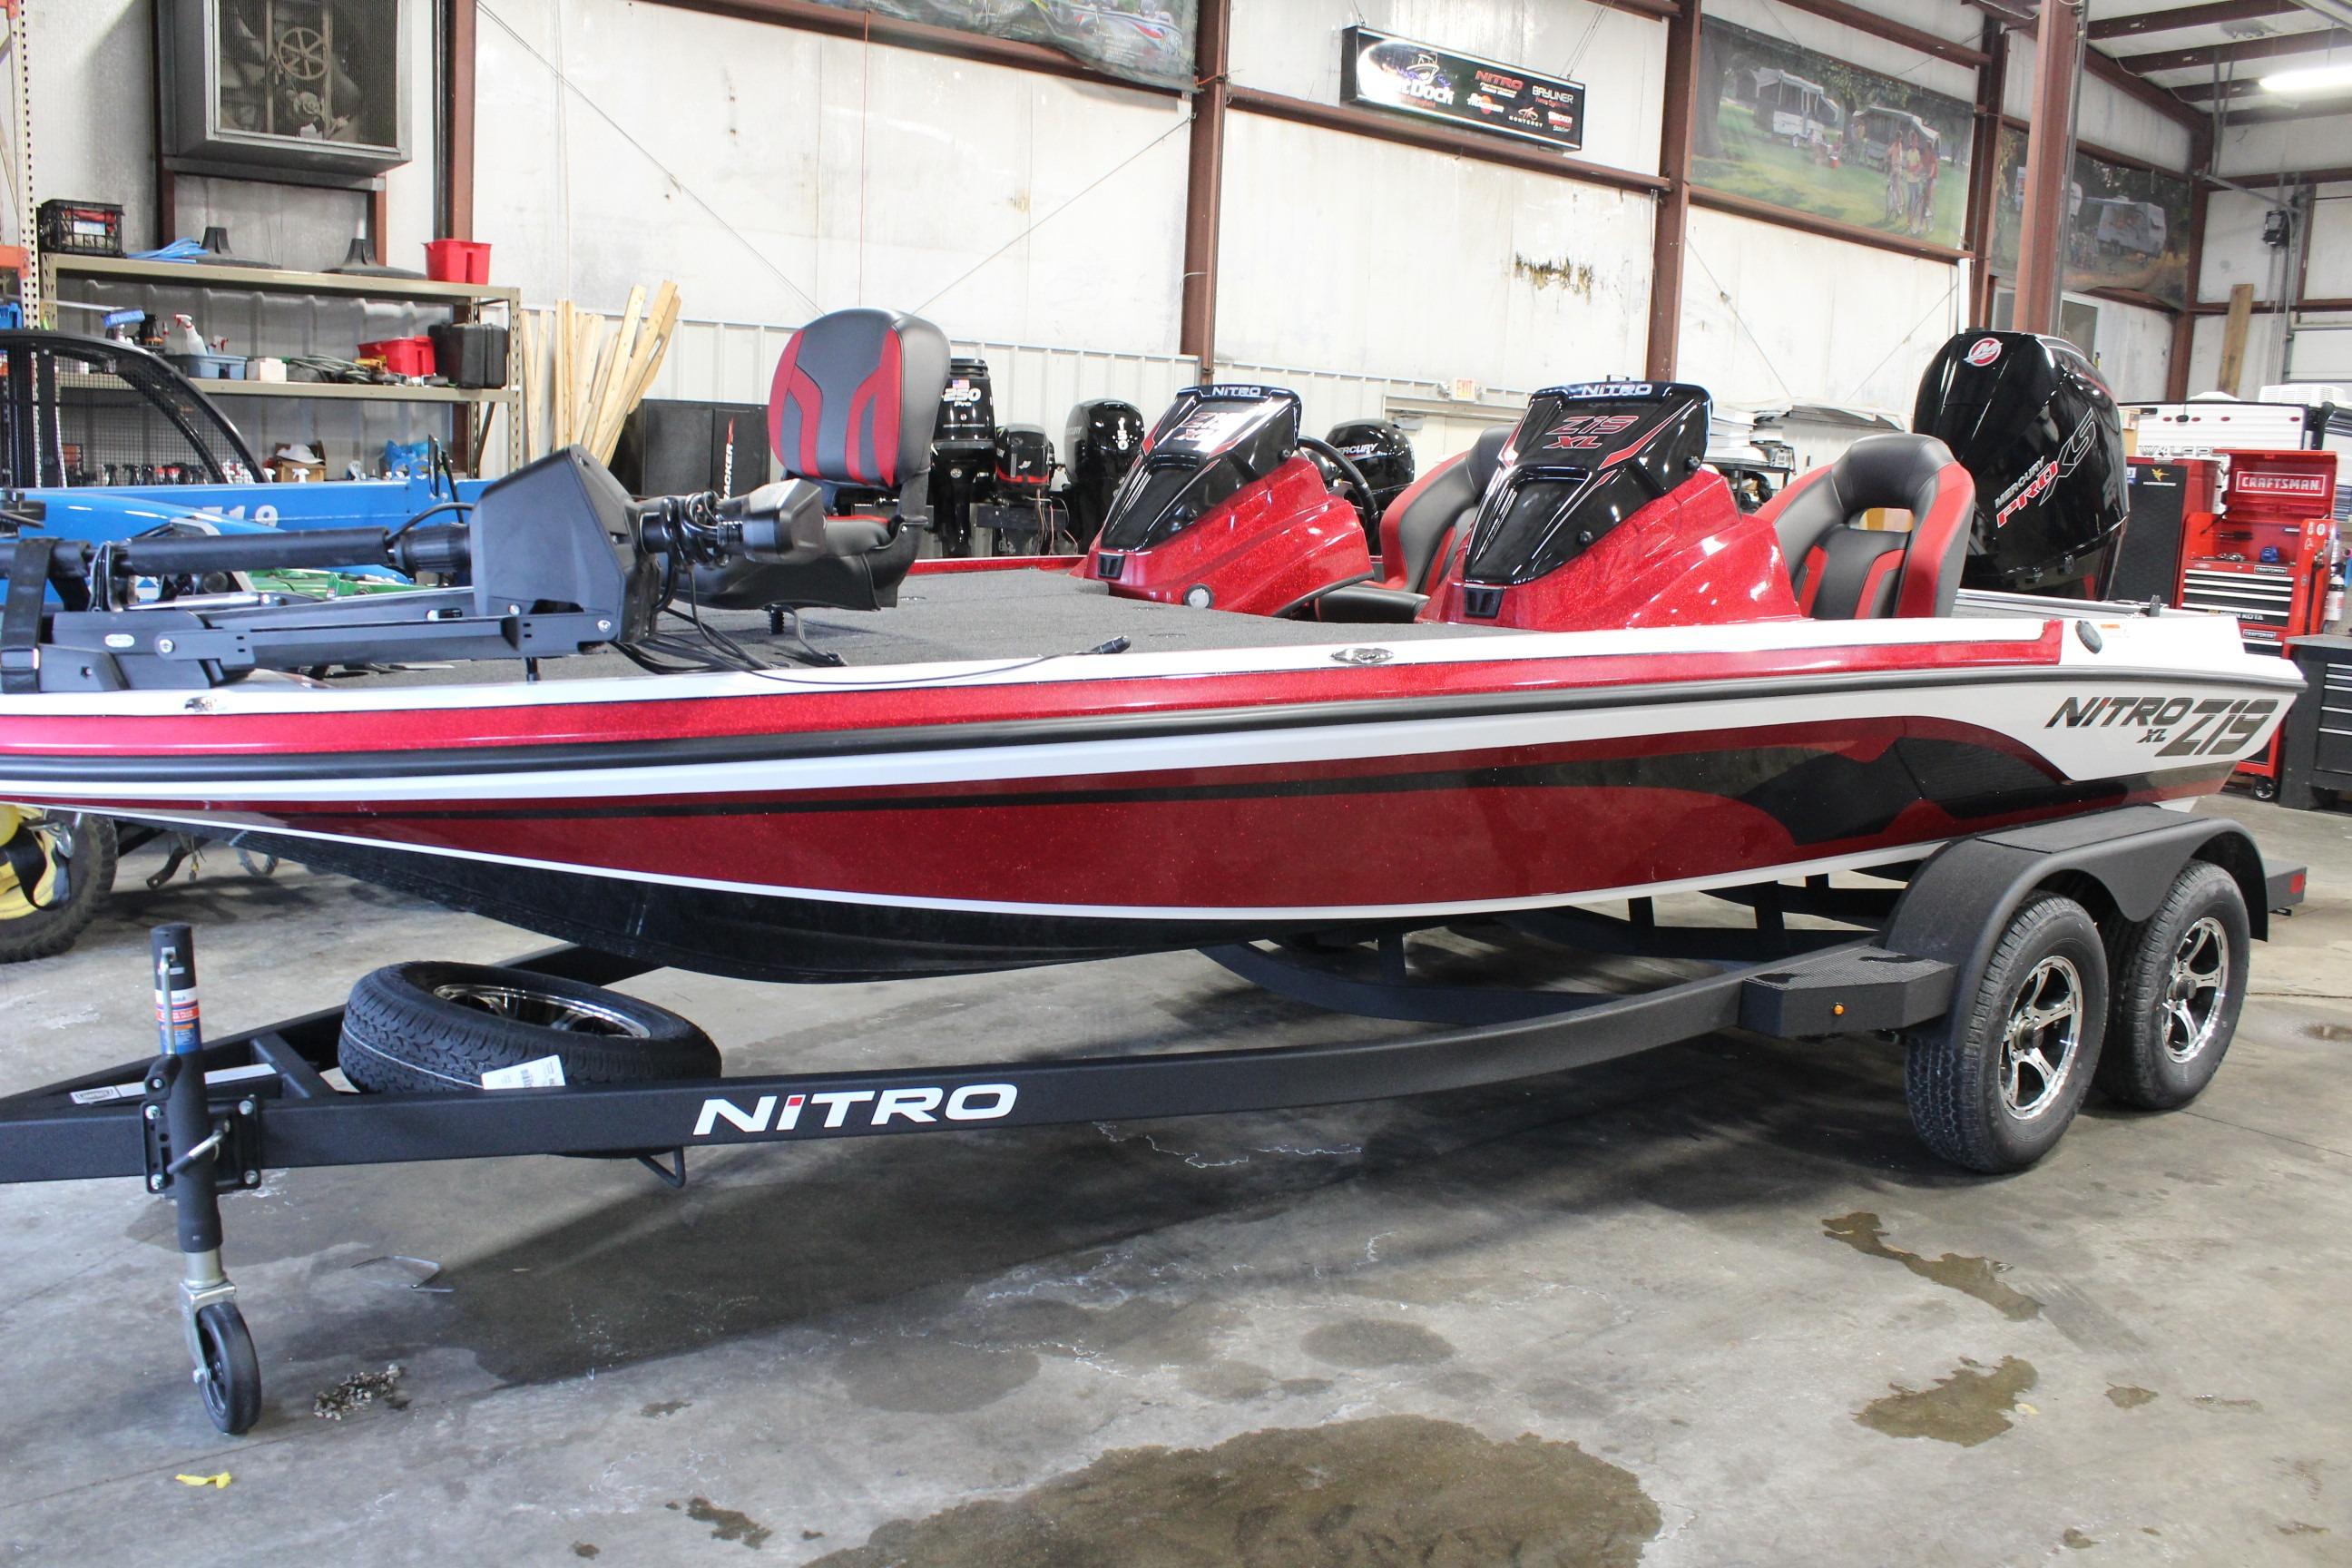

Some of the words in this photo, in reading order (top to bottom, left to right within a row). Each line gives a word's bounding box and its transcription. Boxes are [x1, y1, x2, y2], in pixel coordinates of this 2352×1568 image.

[1475, 70, 1524, 91] NITRO
[1532, 85, 1578, 104] BAYLINER
[1212, 387, 1261, 397] NITRO
[1456, 379, 1472, 392] EXIT
[1582, 384, 1653, 397] NITRO
[943, 387, 982, 402] 250
[1117, 416, 1130, 451] 150
[1545, 416, 1640, 436] Z19
[1337, 443, 1378, 455] ERCURY
[1543, 436, 1603, 449] XL
[1994, 455, 2045, 508] MERCURY
[2241, 476, 2321, 491] CRAFTSMAN
[1996, 460, 2059, 528] PRO
[2241, 612, 2264, 621] KOTA
[2043, 697, 2194, 730] NITRO
[2154, 699, 2279, 758] Z19
[2137, 729, 2168, 743] XL
[692, 1083, 1018, 1135] NITRO
